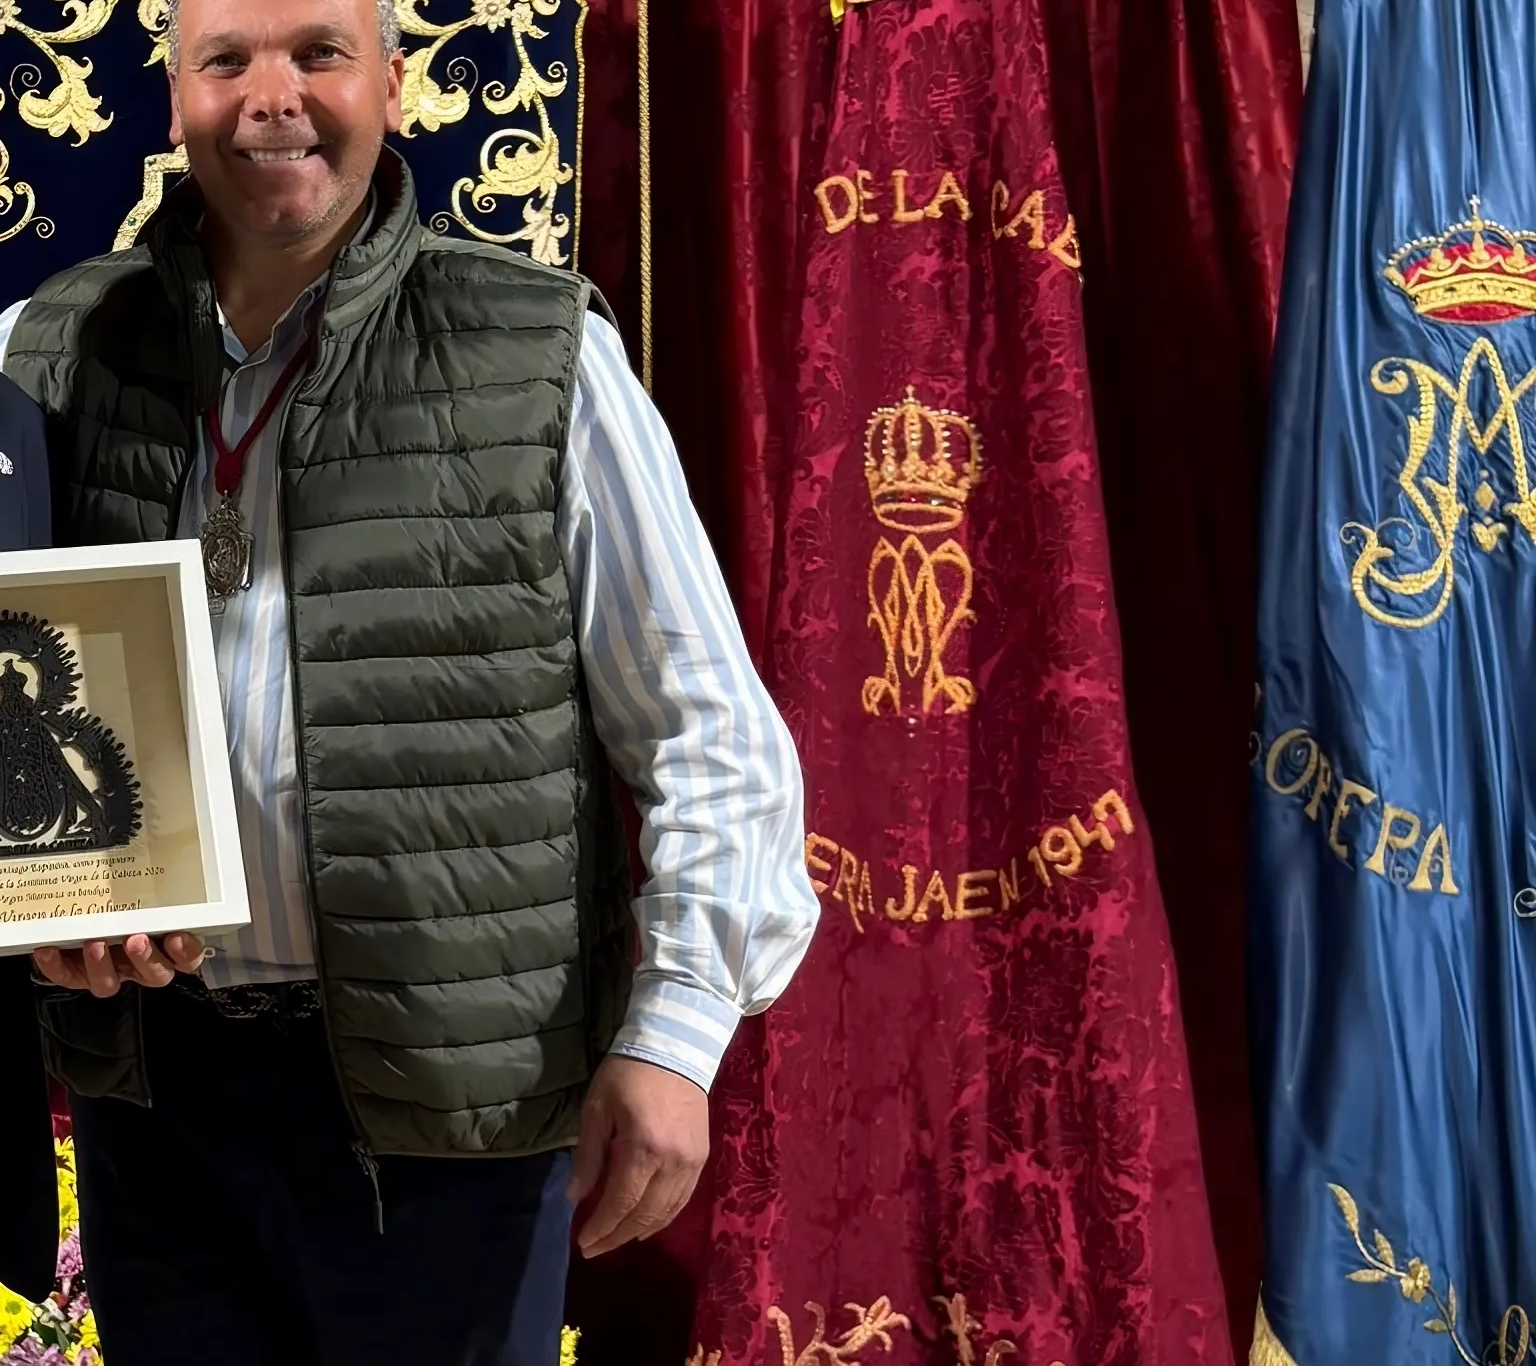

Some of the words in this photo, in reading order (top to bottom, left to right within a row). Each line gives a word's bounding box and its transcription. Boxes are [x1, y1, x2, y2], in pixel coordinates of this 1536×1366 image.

[814, 169, 879, 234] DE
[891, 169, 973, 223] LA
[805, 832, 875, 934] ERA
[885, 856, 1021, 923] JAEN
